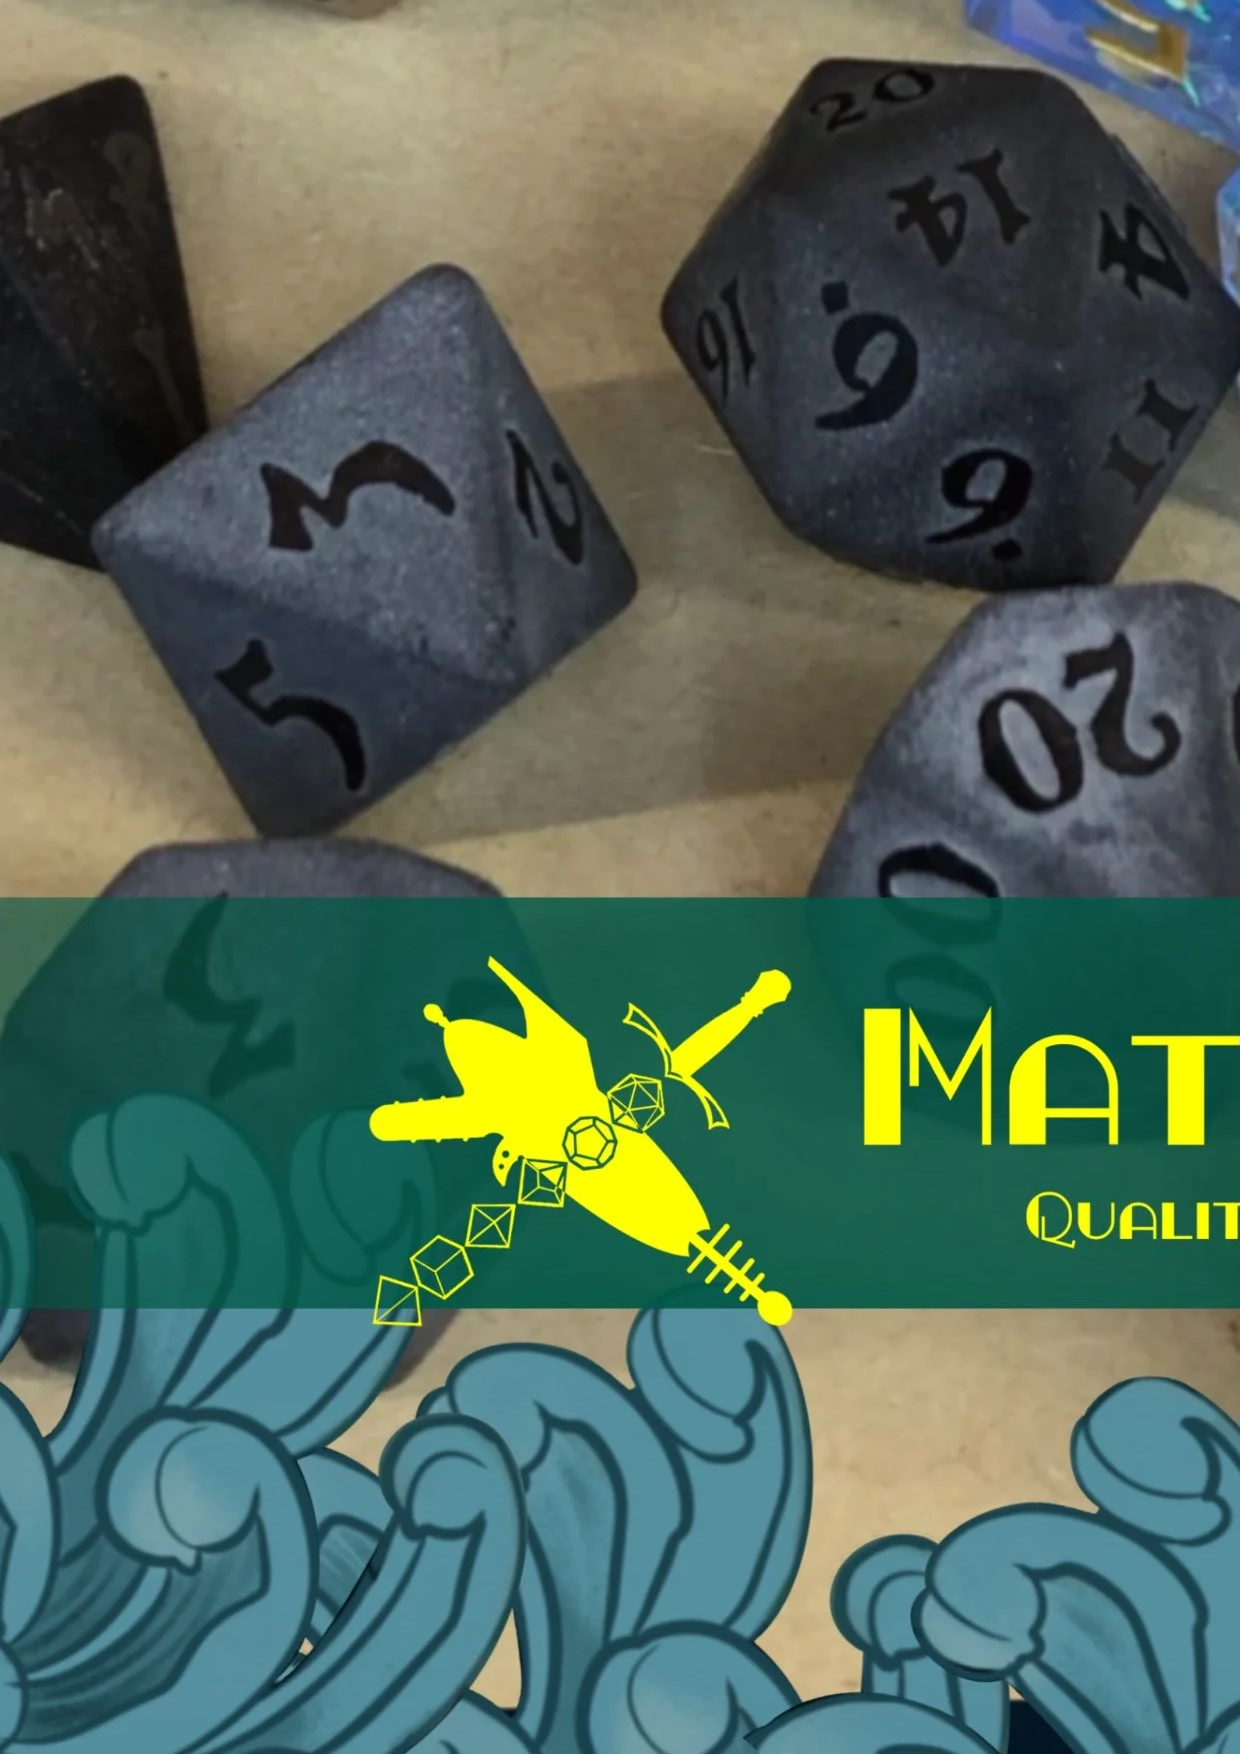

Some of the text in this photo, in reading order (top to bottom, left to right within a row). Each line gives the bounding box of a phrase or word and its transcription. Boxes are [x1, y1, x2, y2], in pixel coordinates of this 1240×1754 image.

[808, 66, 936, 135] 20
[887, 146, 1031, 268] 14
[1098, 200, 1192, 302] 4
[977, 631, 1182, 815] 20
